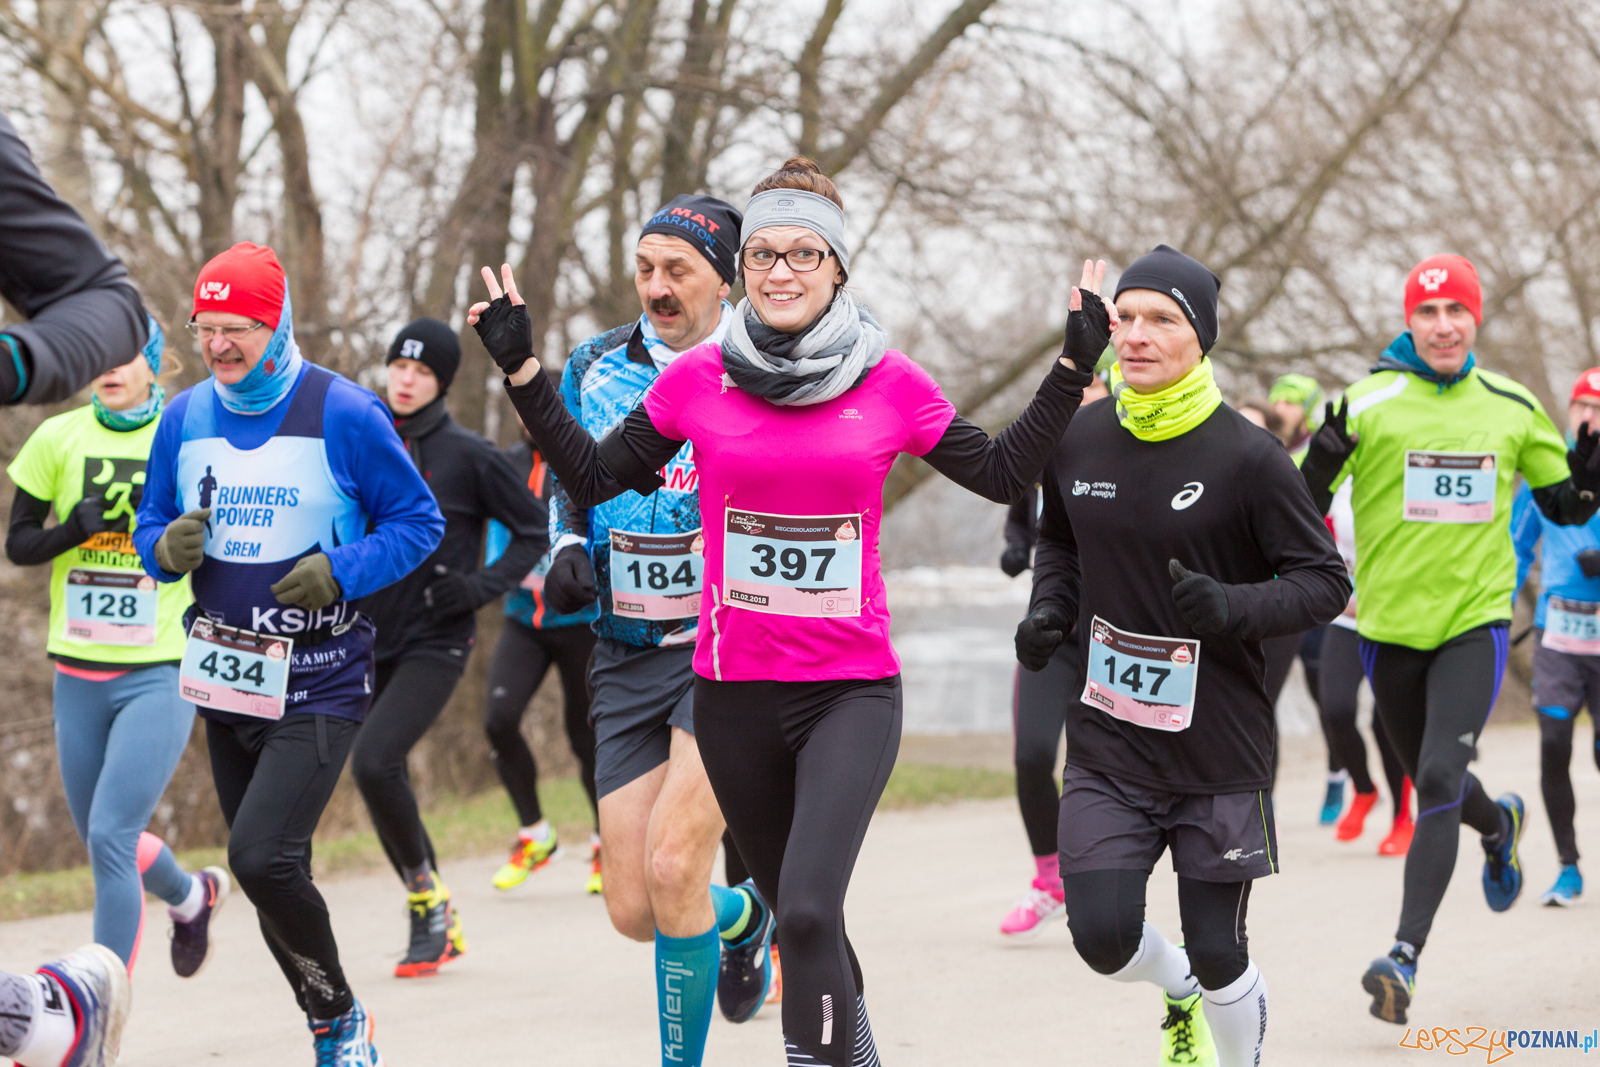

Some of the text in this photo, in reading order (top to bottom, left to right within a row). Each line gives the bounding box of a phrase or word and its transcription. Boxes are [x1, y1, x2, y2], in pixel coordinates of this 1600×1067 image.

[670, 207, 721, 233] MAT
[1435, 474, 1473, 498] 85
[216, 507, 274, 528] POWER
[223, 538, 262, 558] ŚREM
[627, 560, 696, 590] 184
[750, 543, 836, 582] 397
[81, 592, 137, 618] 128
[731, 591, 767, 605] 11.02.2018
[199, 651, 265, 687] 434
[1104, 655, 1171, 696] 147
